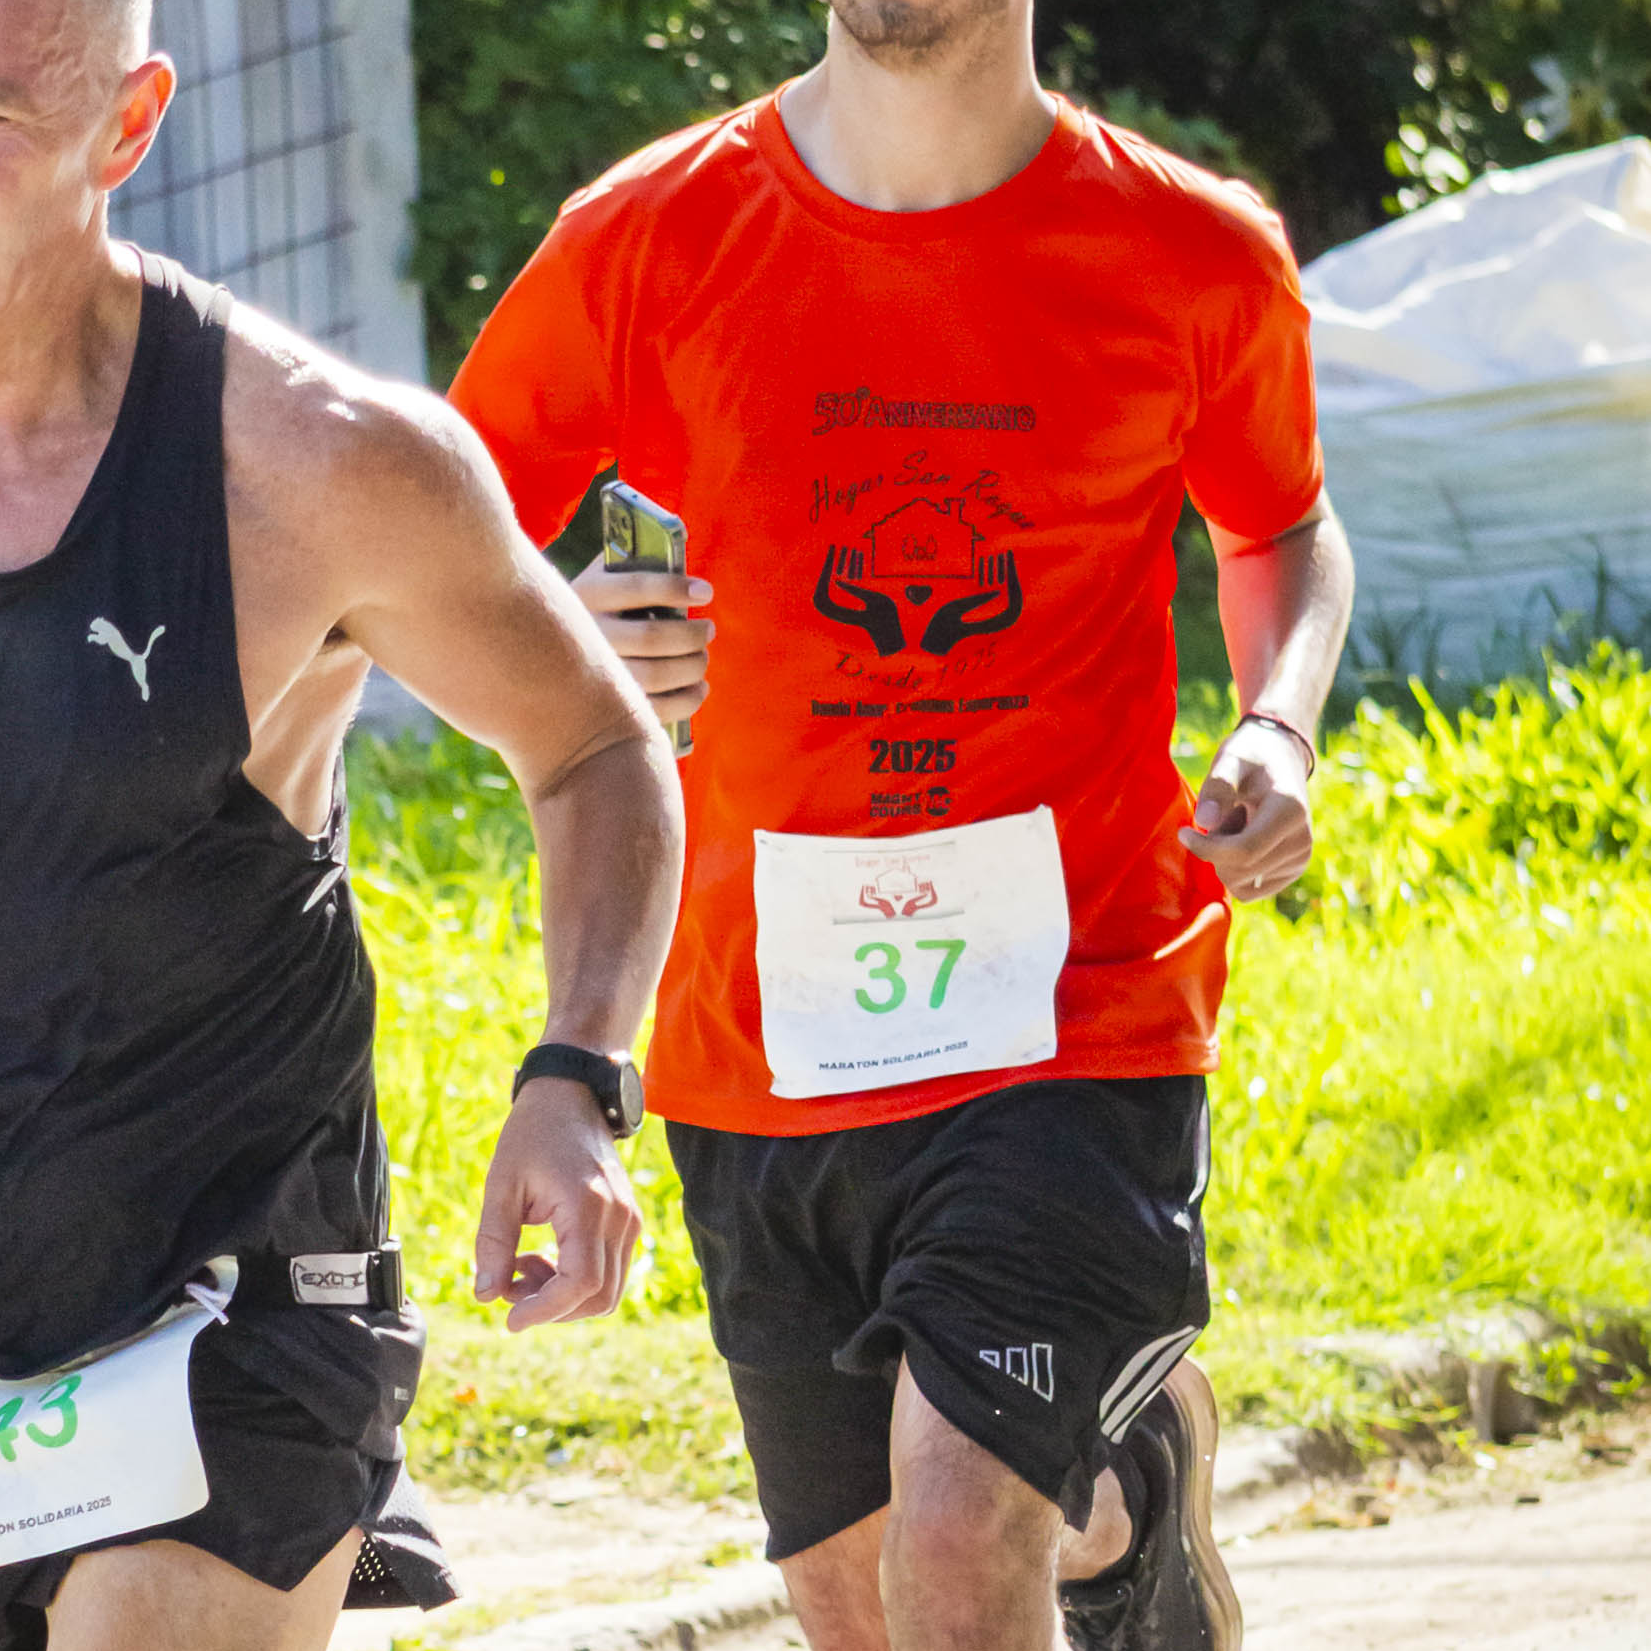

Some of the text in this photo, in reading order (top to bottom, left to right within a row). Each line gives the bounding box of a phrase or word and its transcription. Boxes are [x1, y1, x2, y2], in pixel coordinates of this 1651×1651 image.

[866, 396, 1037, 432] ANIVERSARIO
[894, 450, 952, 486] San
[869, 739, 957, 775] 2025
[854, 938, 967, 1015] 37
[818, 1040, 969, 1072] MARATON SOLIDARIA 2025
[18, 1503, 85, 1532] SOLIDARIA
[86, 1495, 113, 1515] 2025
